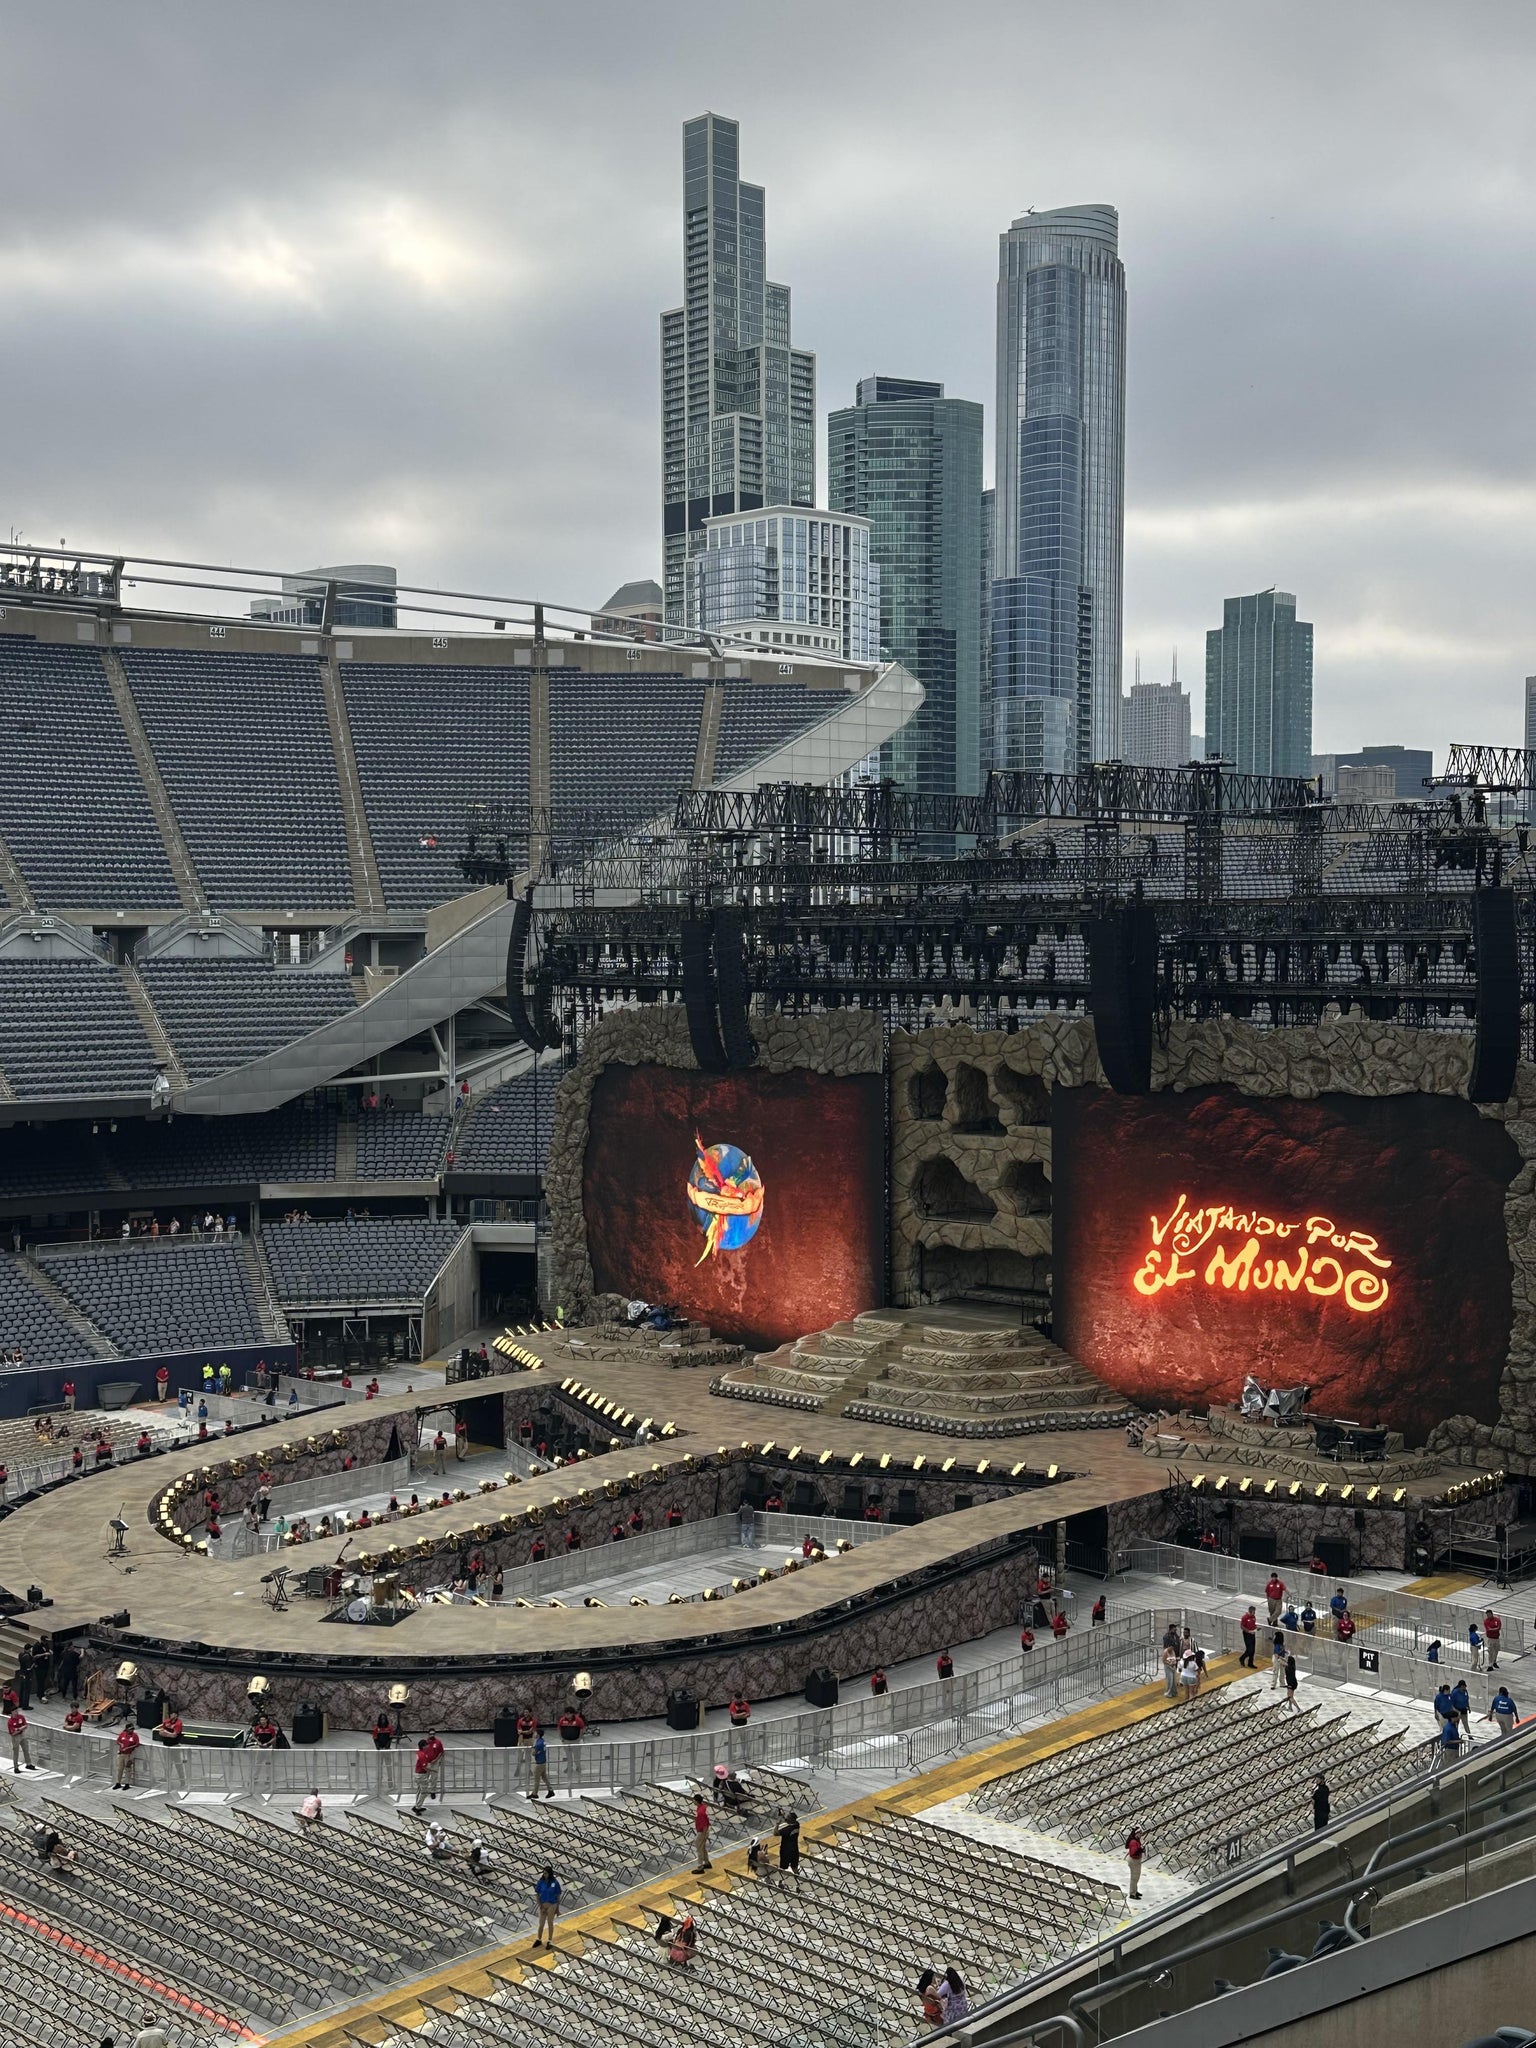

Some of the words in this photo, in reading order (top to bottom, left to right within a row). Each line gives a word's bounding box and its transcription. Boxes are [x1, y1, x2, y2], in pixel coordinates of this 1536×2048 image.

[210, 626, 225, 637] 444
[433, 638, 447, 648] 445
[779, 664, 793, 674] 447
[1362, 1651, 1375, 1660] PIT
[1229, 1839, 1240, 1860] A1
